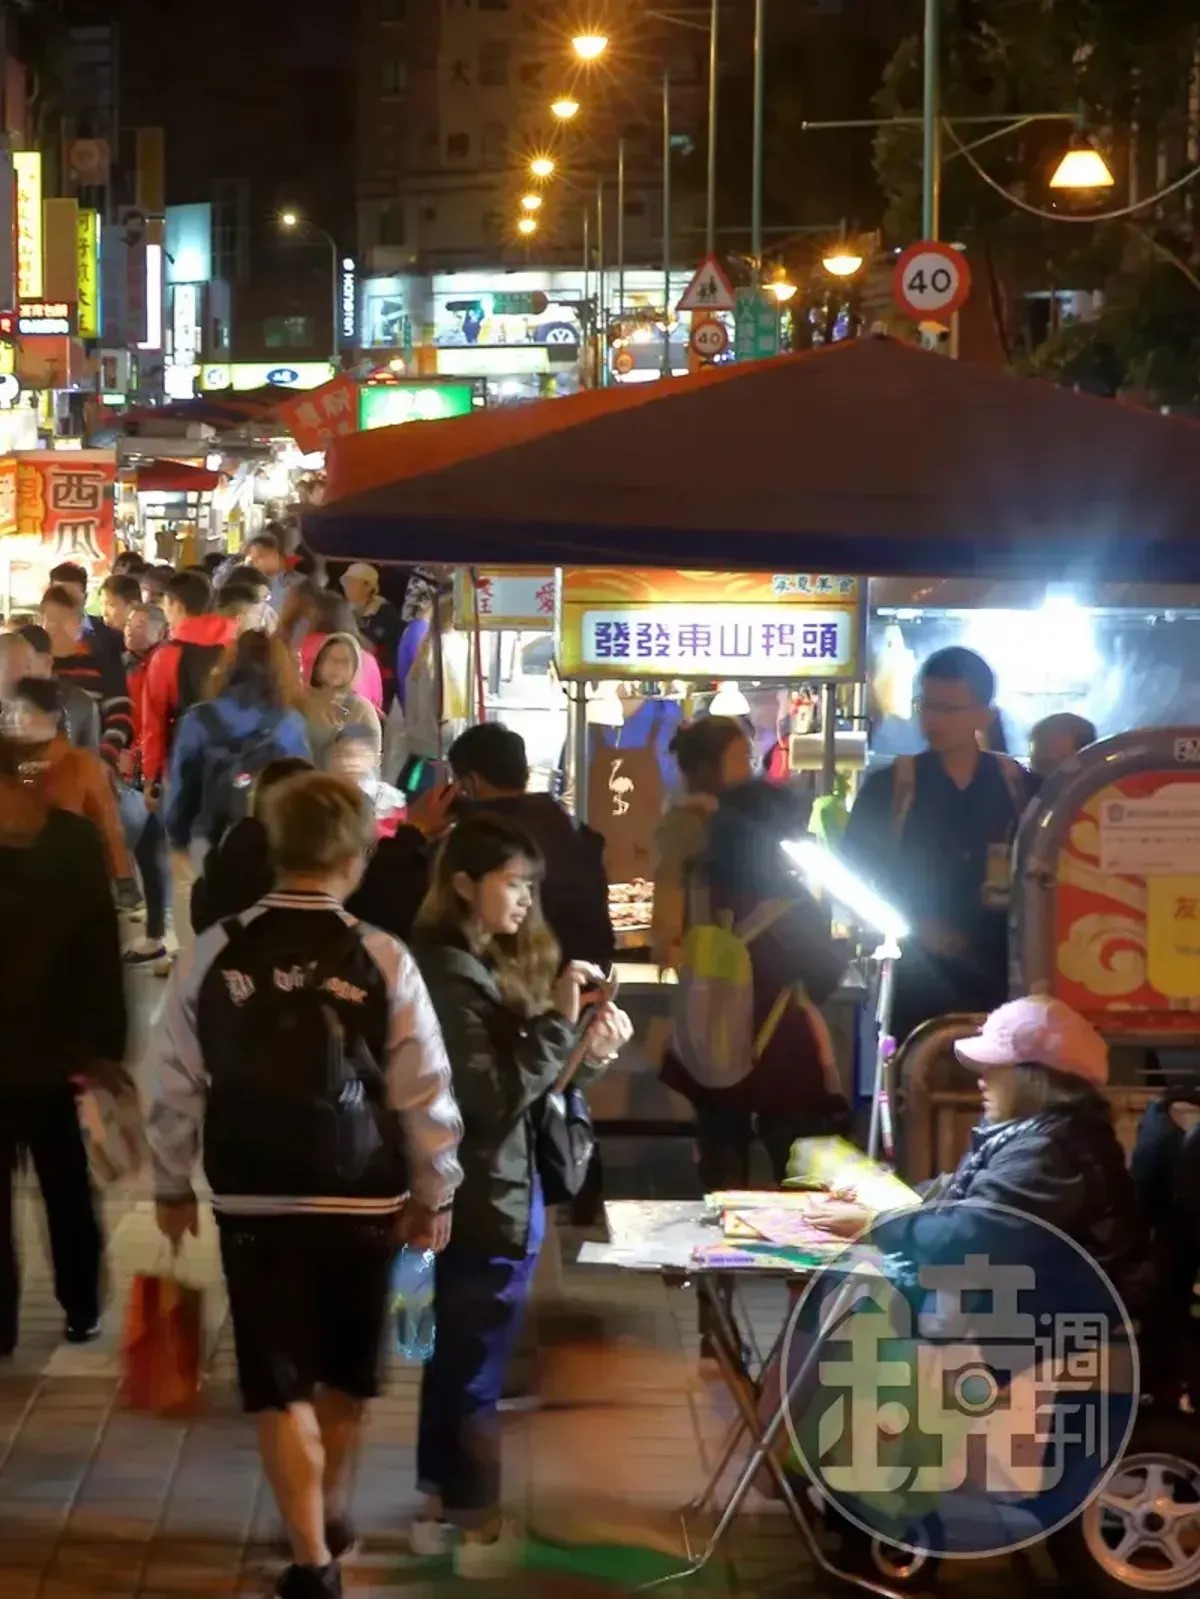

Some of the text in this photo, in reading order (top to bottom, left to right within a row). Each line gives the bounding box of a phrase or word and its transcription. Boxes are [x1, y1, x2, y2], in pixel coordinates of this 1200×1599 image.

[907, 269, 952, 295] 40
[698, 332, 721, 345] 40
[50, 466, 106, 559] 西瓜
[595, 621, 839, 658] 發發東山鴨頭
